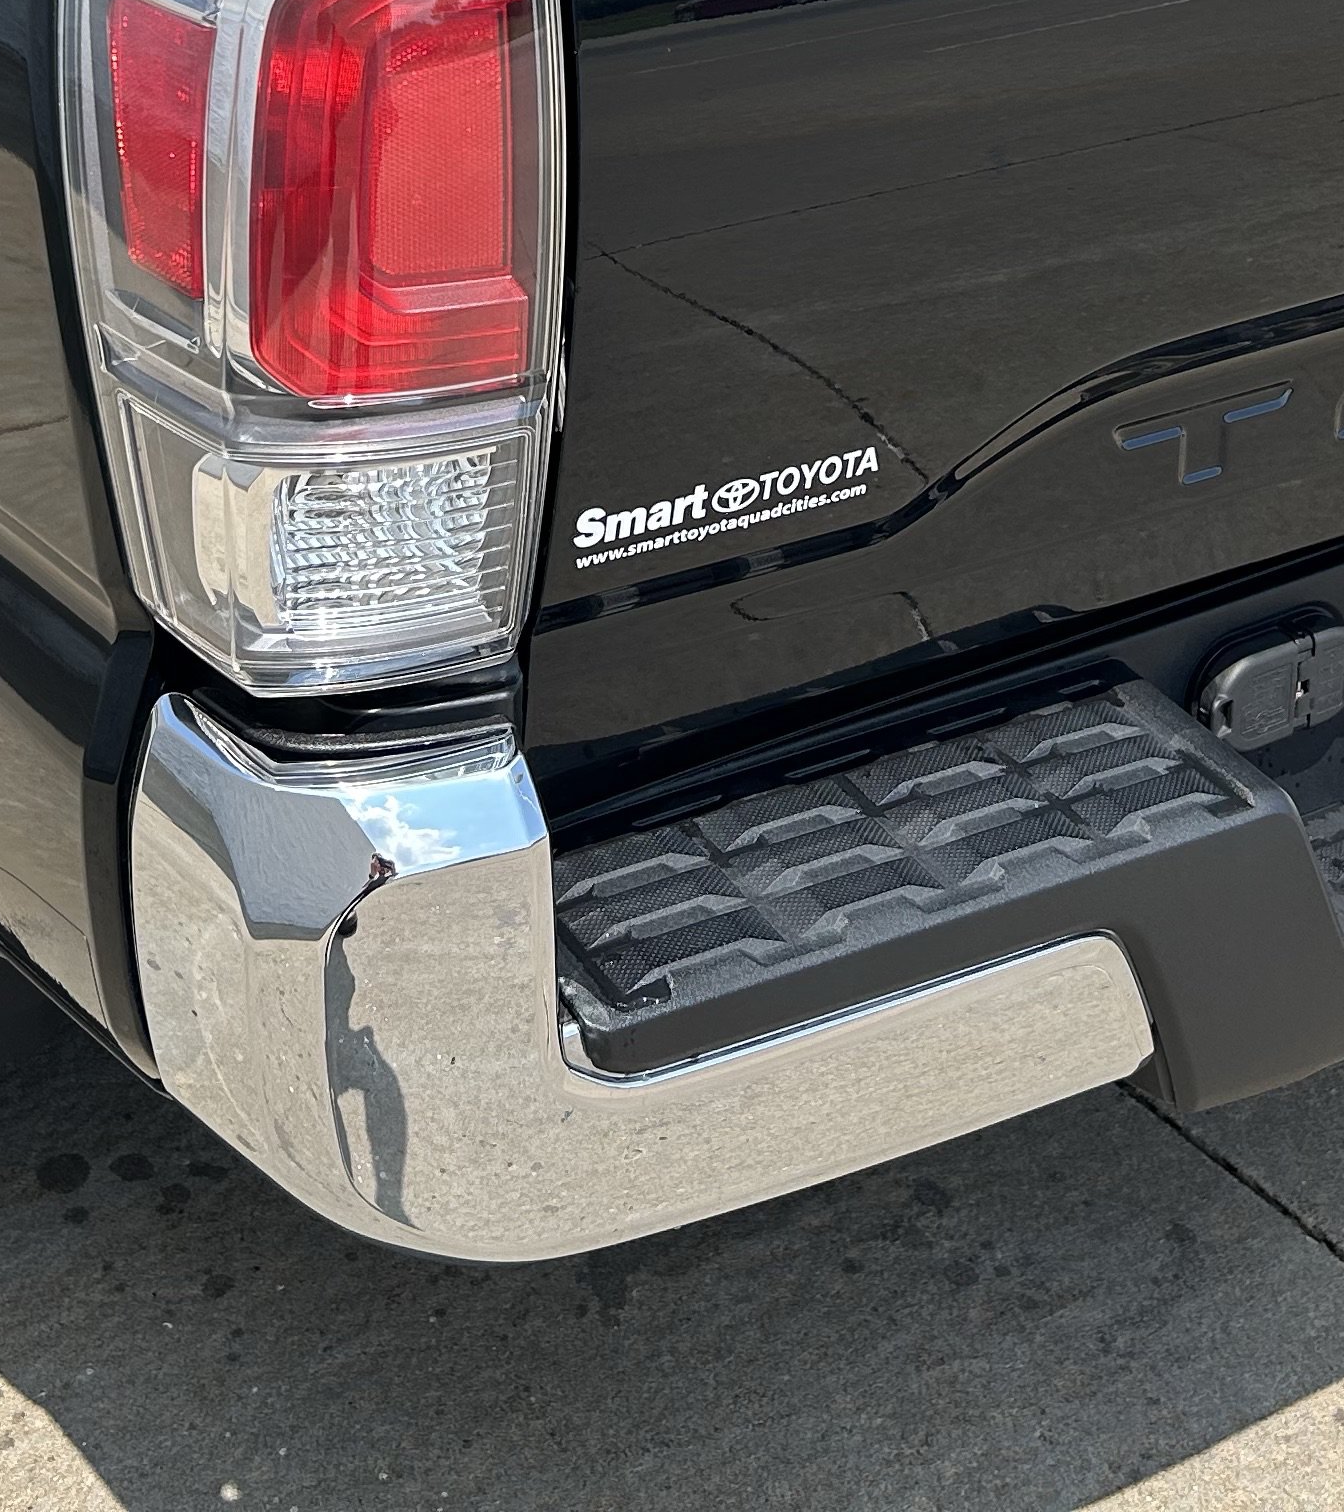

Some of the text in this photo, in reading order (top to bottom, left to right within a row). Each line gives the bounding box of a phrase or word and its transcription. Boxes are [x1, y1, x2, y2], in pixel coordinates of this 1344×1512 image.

[573, 446, 879, 549] Smart TOYOTA
[575, 483, 867, 569] www.smarttoyotaquadcities.com
